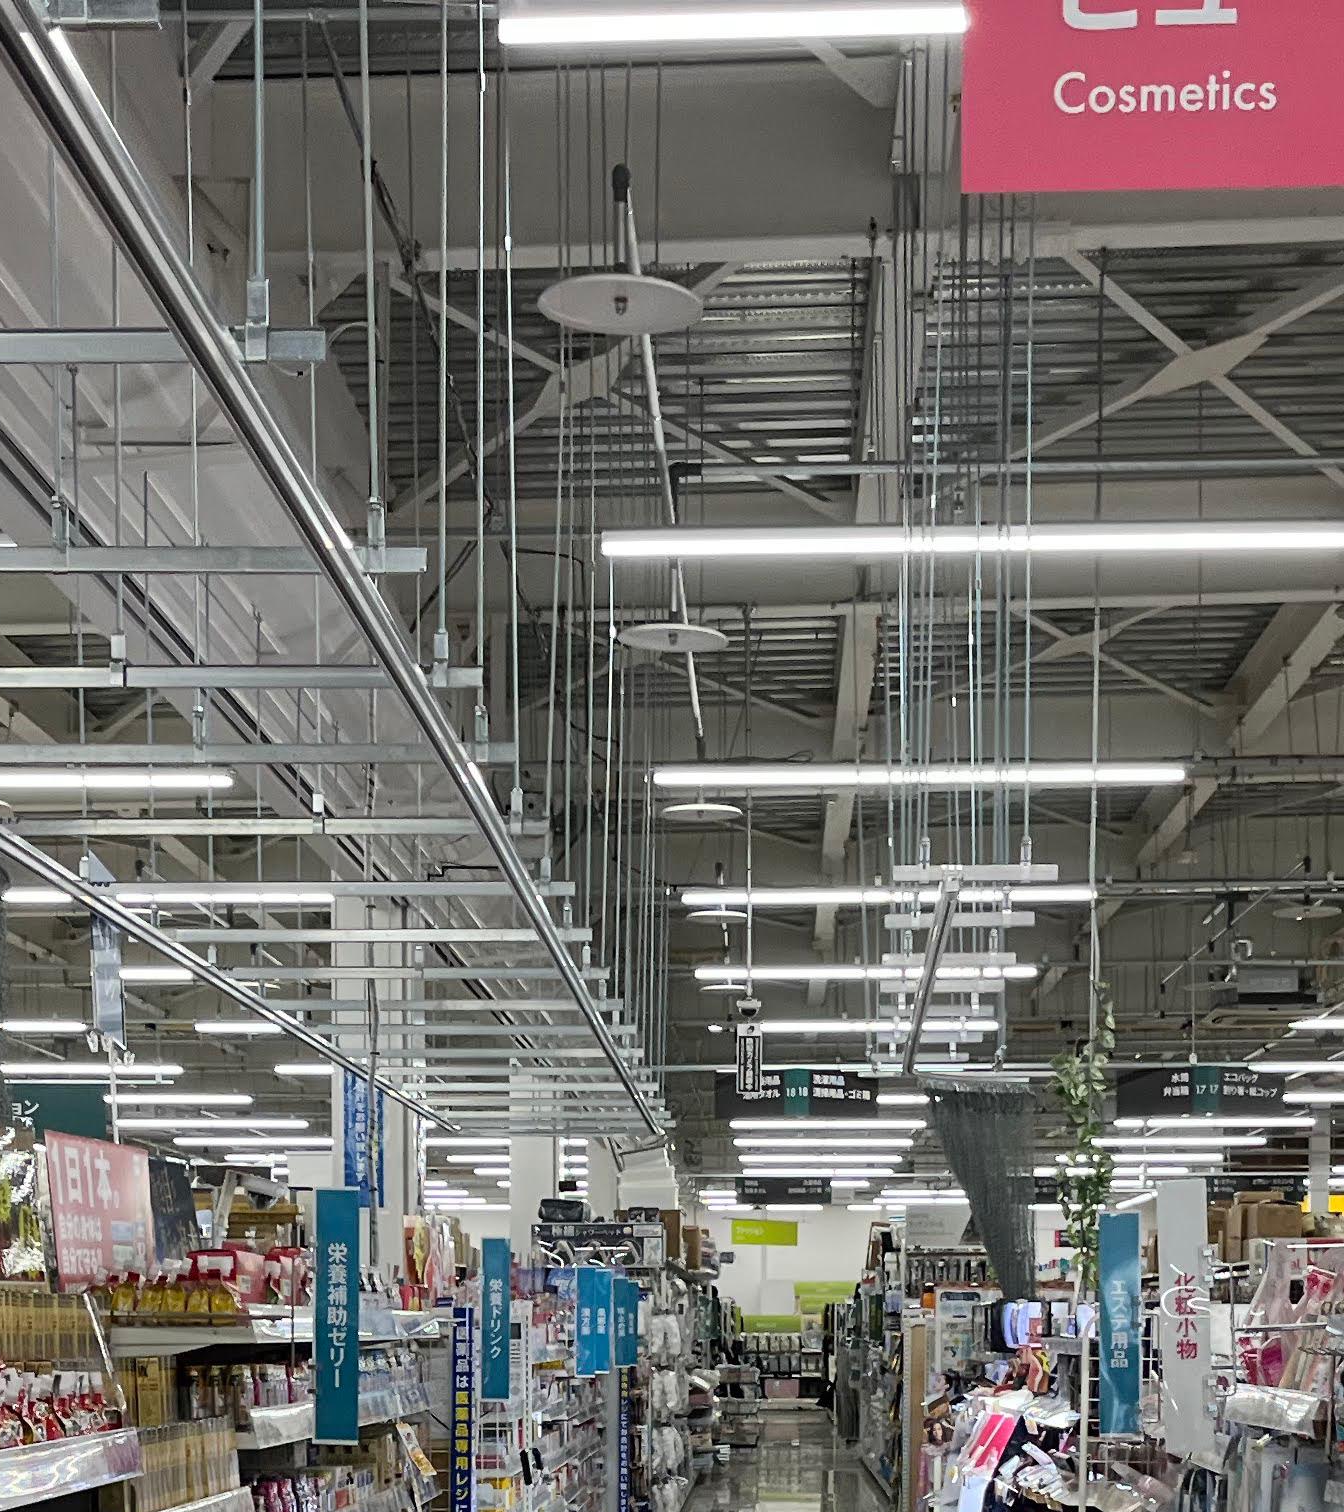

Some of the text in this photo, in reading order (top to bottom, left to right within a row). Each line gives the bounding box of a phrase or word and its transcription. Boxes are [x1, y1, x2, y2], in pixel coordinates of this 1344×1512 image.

[1052, 70, 1278, 115] Cosmetics
[1196, 1085, 1206, 1095] 17
[1209, 1084, 1219, 1094] 17
[326, 1242, 349, 1389] 栄養補助ゼリー
[1110, 1279, 1129, 1369] エステ用品
